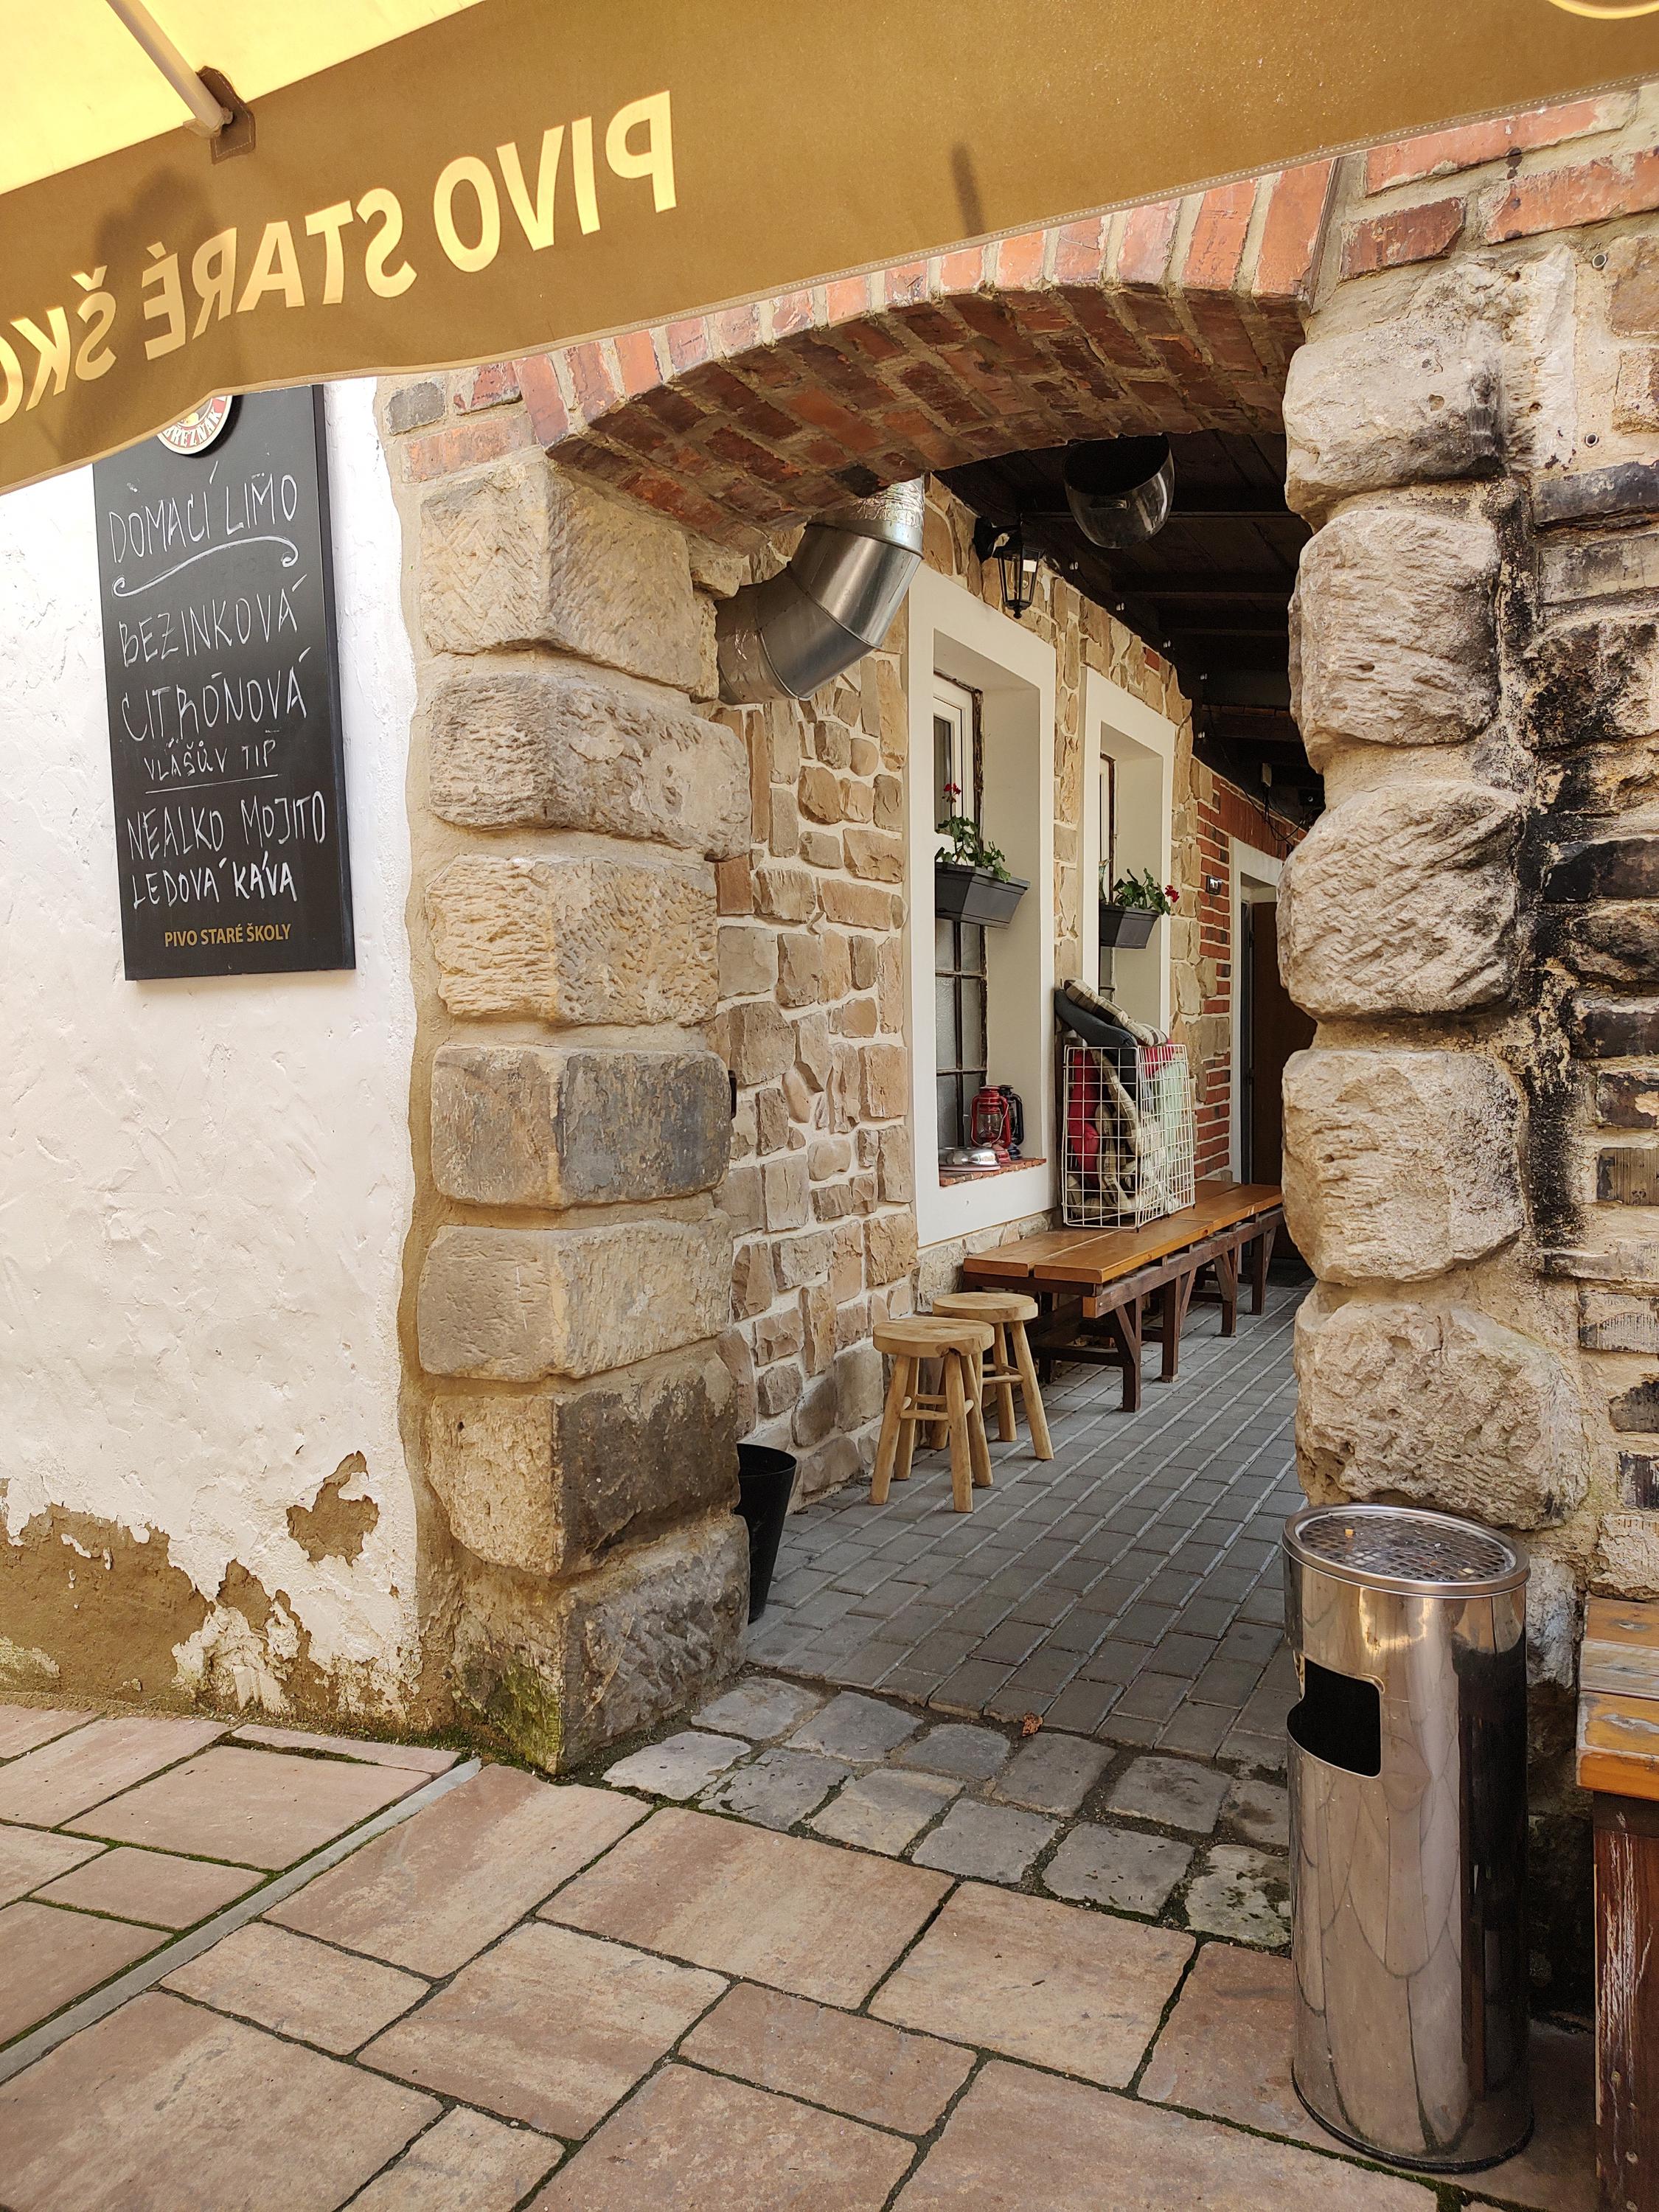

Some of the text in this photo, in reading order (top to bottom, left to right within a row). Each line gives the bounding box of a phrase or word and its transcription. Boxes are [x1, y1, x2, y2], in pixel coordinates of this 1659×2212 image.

[226, 473, 297, 536] LIMO
[119, 574, 307, 667] BEZINKOVÁ
[122, 647, 311, 742] CITRÓNOVÁ
[242, 739, 276, 771] TIP
[127, 790, 327, 860] NEALKO MOJITO
[132, 852, 298, 910] LEDOVÁ KÁVA
[164, 922, 291, 947] PIVO STARÉ ŠKOLY
